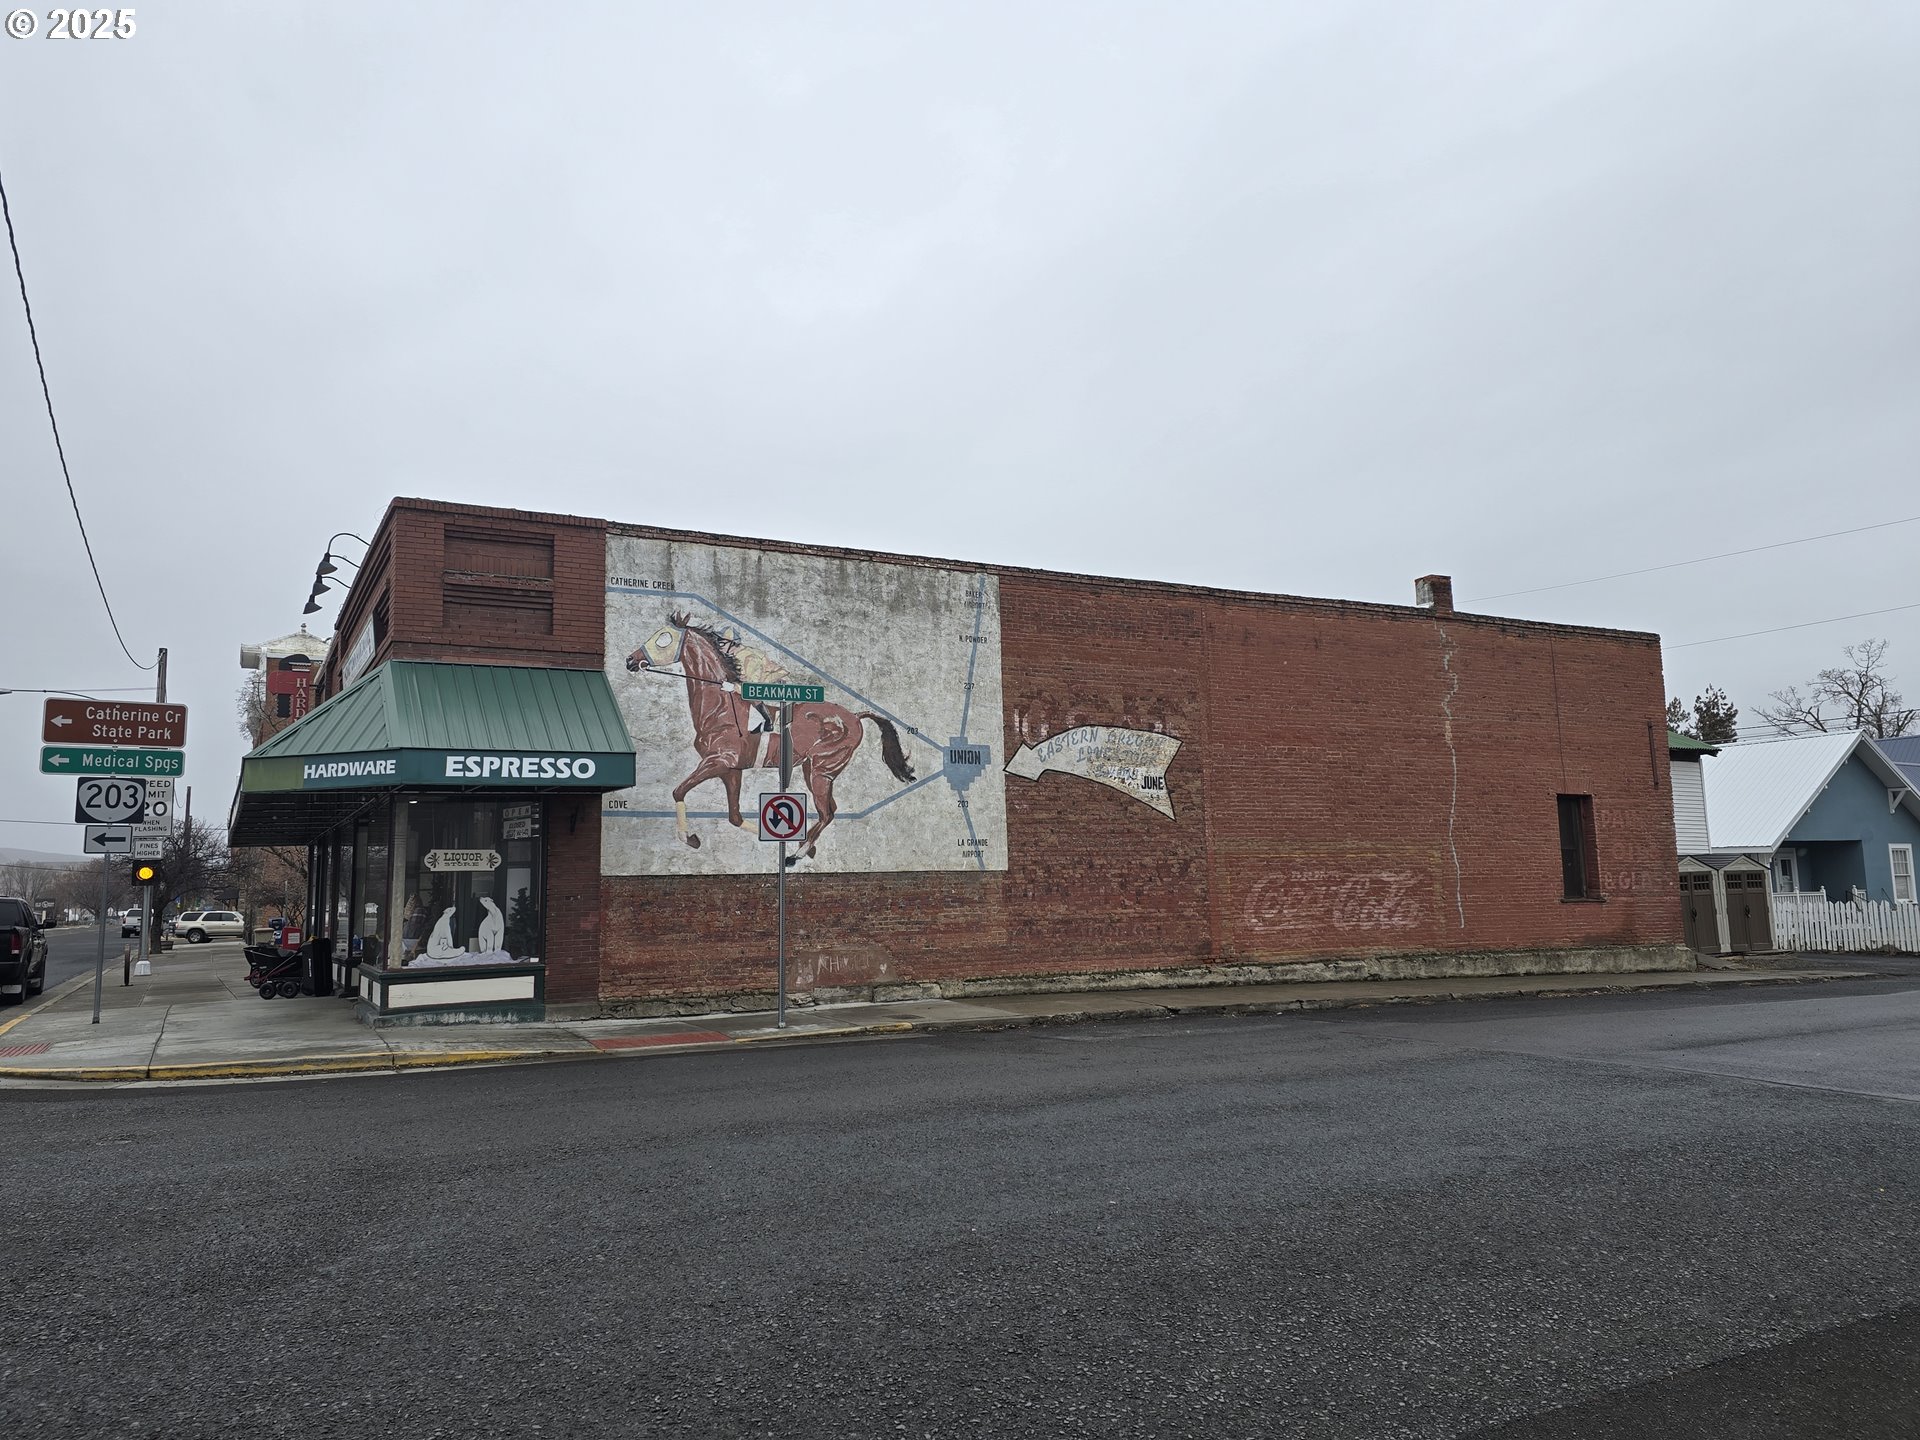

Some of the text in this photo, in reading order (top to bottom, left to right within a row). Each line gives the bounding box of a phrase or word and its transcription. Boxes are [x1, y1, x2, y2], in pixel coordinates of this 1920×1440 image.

[610, 576, 675, 590] CATHERINE CREEK
[748, 685, 819, 700] BEAKMAN ST
[86, 706, 182, 723] Catherine Cr
[92, 724, 171, 739] State Park
[907, 727, 919, 735] 203
[1037, 728, 1099, 763] EASTERN
[82, 754, 179, 772] Medical Spgs
[950, 750, 981, 765] UNION
[303, 756, 596, 779] HARDWARE ESPRESSO
[1141, 776, 1164, 790] JUNE
[85, 783, 138, 809] 203
[608, 800, 628, 809] COVE
[957, 800, 969, 808] 203
[505, 807, 530, 818] OPEN
[967, 839, 988, 847] GRANDE
[443, 852, 484, 864] LIQUOR
[962, 850, 984, 858] AIRPORT
